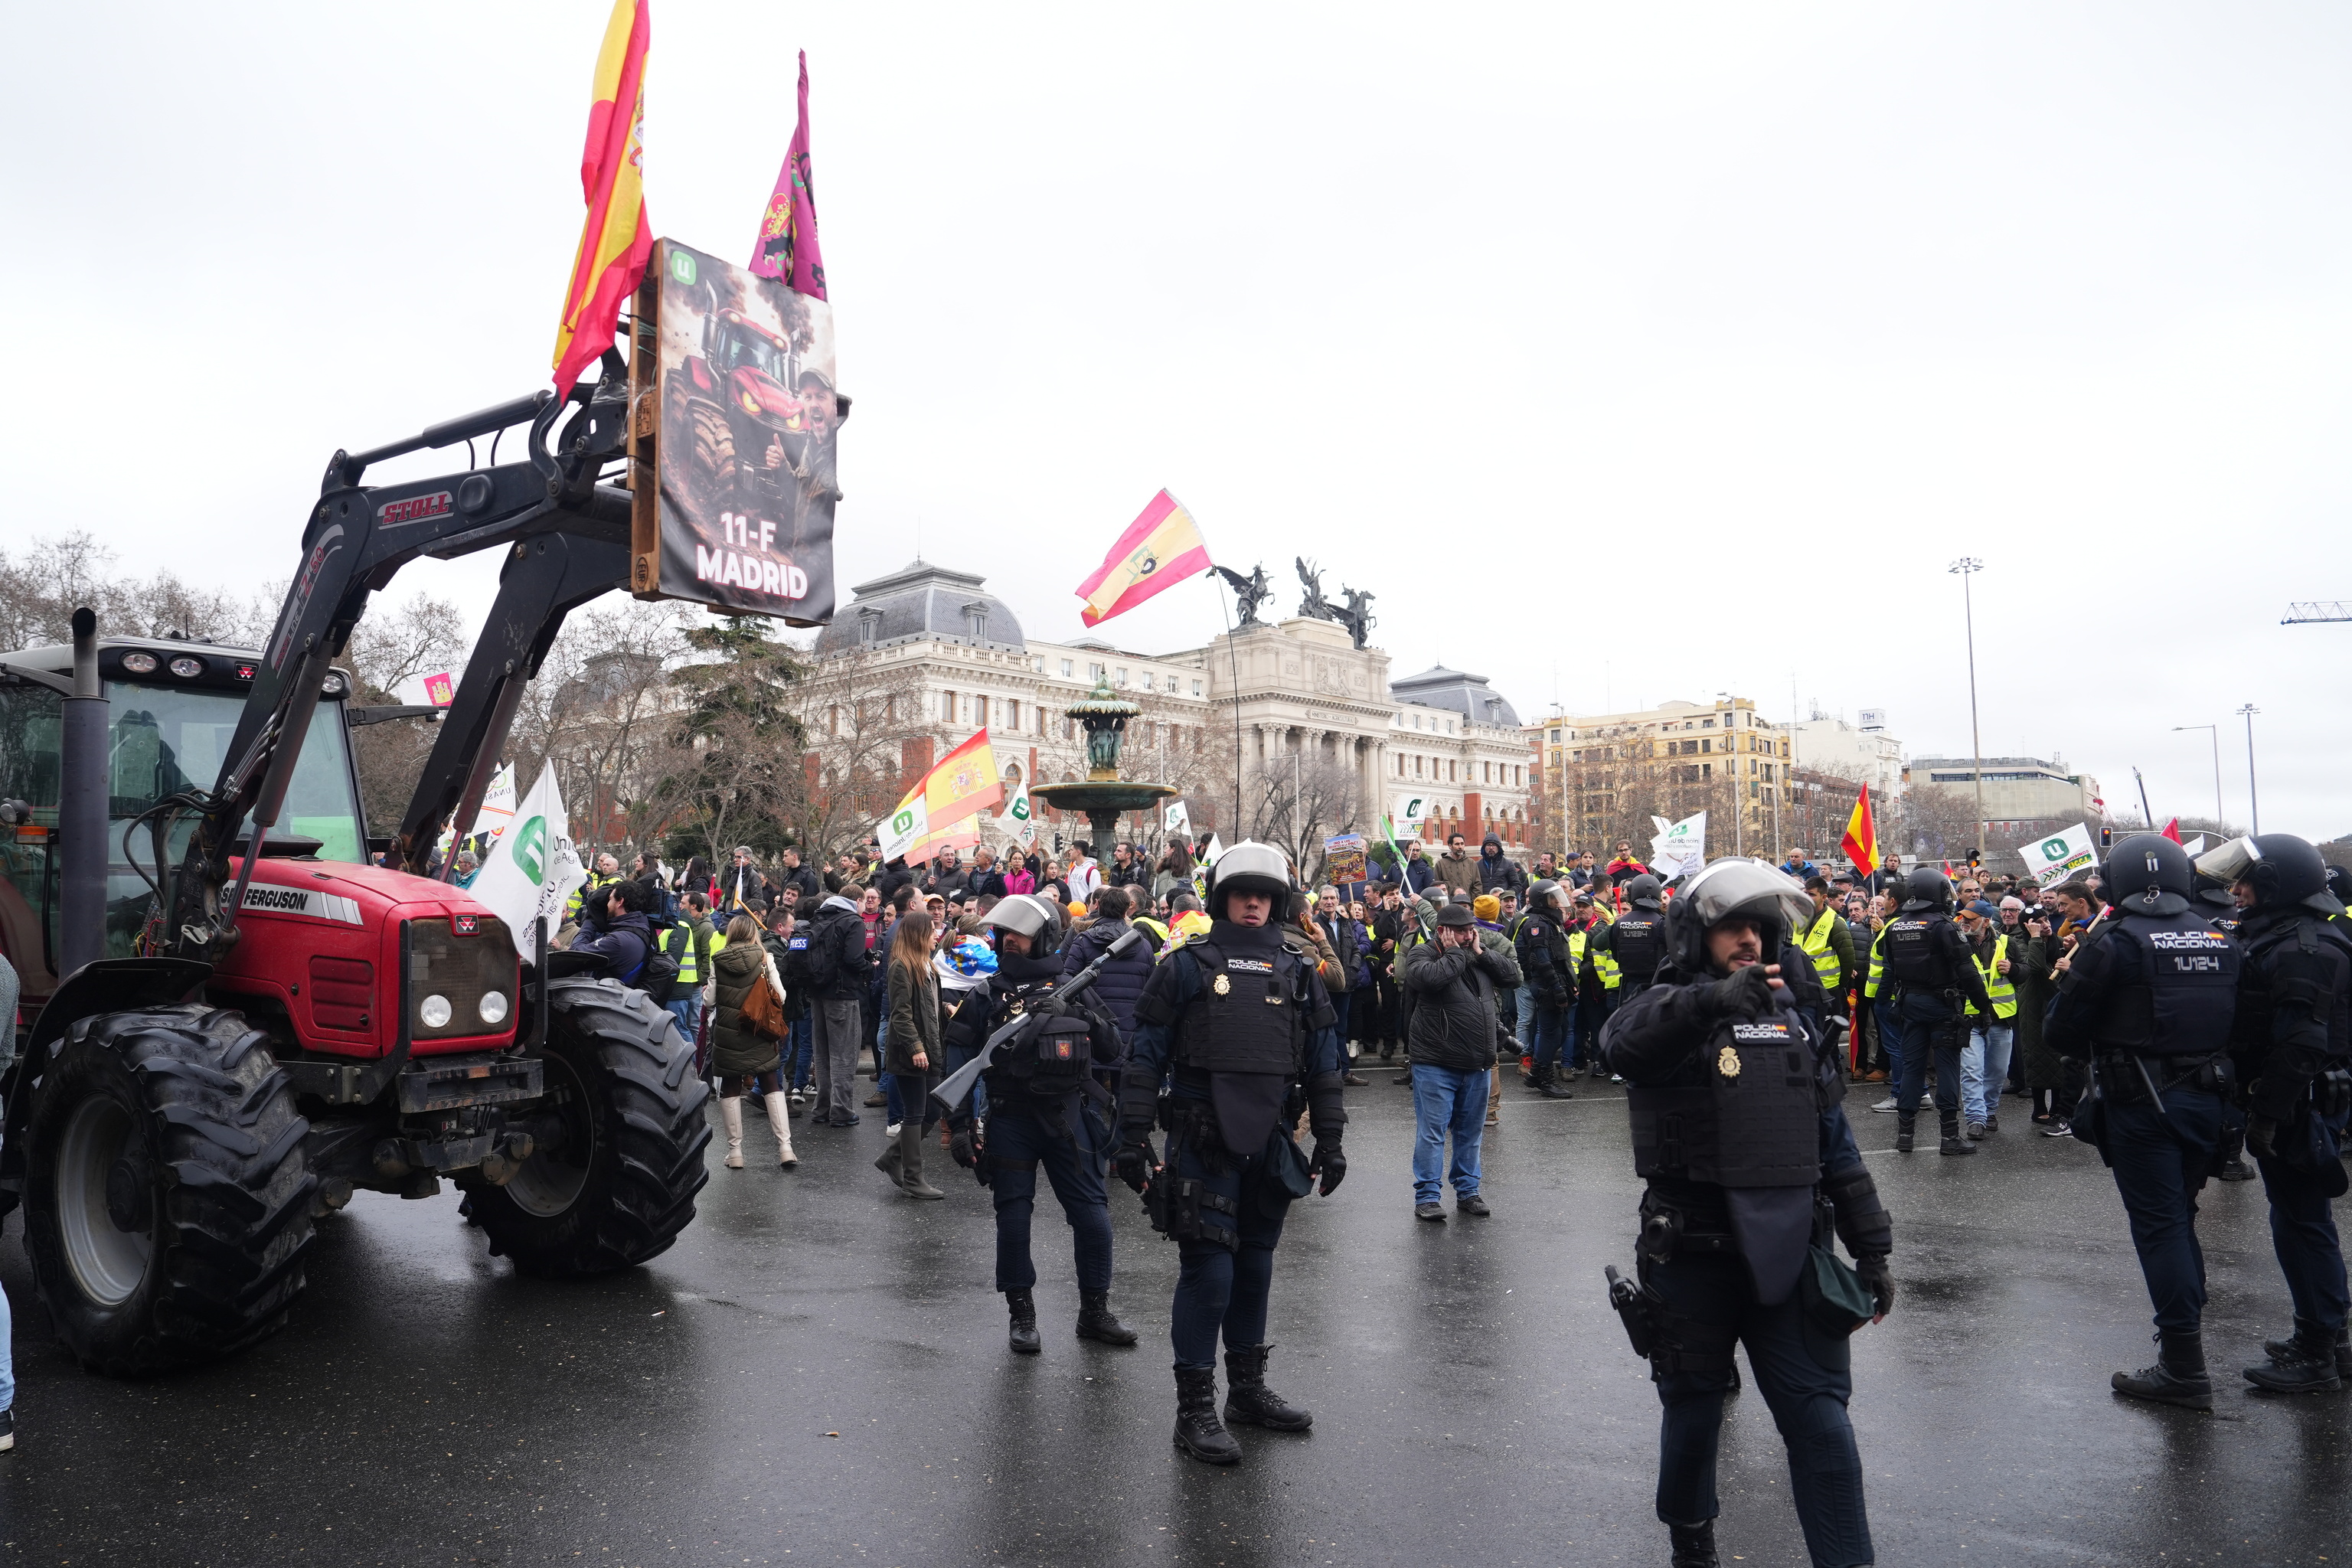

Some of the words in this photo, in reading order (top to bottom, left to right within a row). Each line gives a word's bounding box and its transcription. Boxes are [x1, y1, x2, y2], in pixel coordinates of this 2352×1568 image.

[383, 494, 449, 524] STOLL
[720, 511, 777, 553] 11-F
[310, 546, 325, 574] 50
[637, 563, 647, 583] EUR
[697, 544, 808, 600] MADRID
[2037, 867, 2053, 875] UNION
[2060, 849, 2089, 866] CAMPESINOS
[243, 889, 308, 911] FERGUSON
[2149, 931, 2213, 941] POLICIA
[789, 939, 807, 949] PRESS
[2154, 939, 2229, 949] NACIONAL
[1228, 959, 1264, 967] POLICIA
[1228, 963, 1273, 972] NACIONAL
[2174, 956, 2220, 971] 1U124
[1733, 1024, 1779, 1032] POLICIA
[1735, 1031, 1790, 1039] NACIONAL
